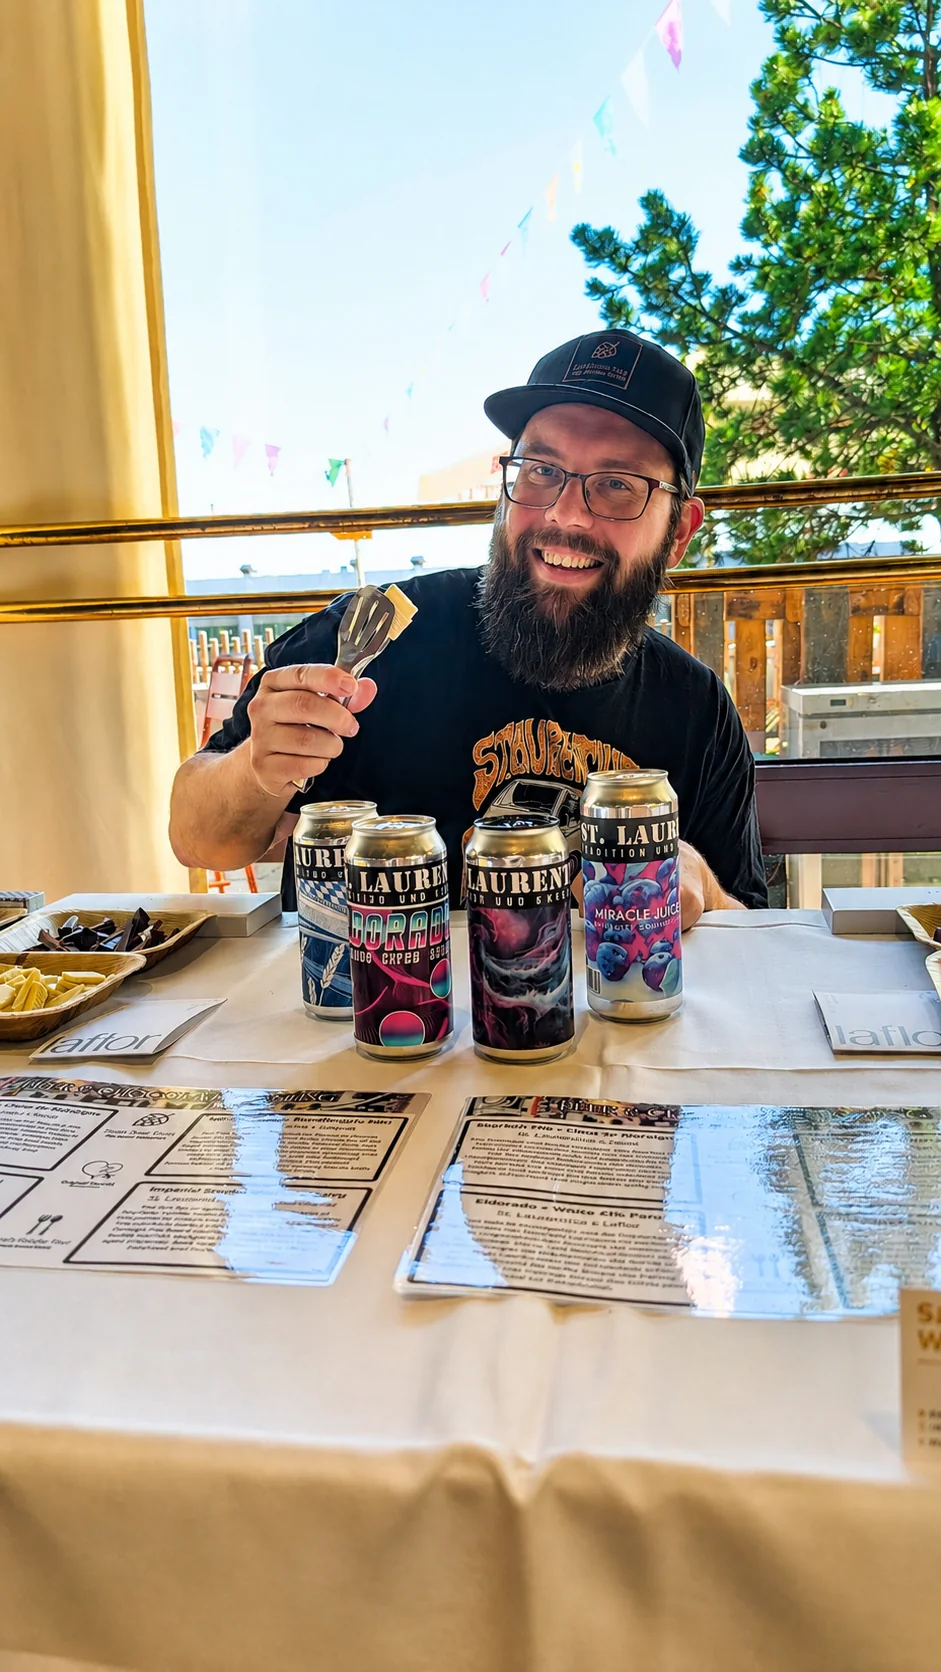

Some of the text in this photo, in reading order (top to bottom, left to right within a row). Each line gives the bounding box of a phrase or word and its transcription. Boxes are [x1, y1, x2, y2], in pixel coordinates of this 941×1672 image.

[581, 822, 605, 845] ST.
[595, 902, 680, 922] MIRACLE JUICE
[475, 1198, 537, 1210] Eldorado
